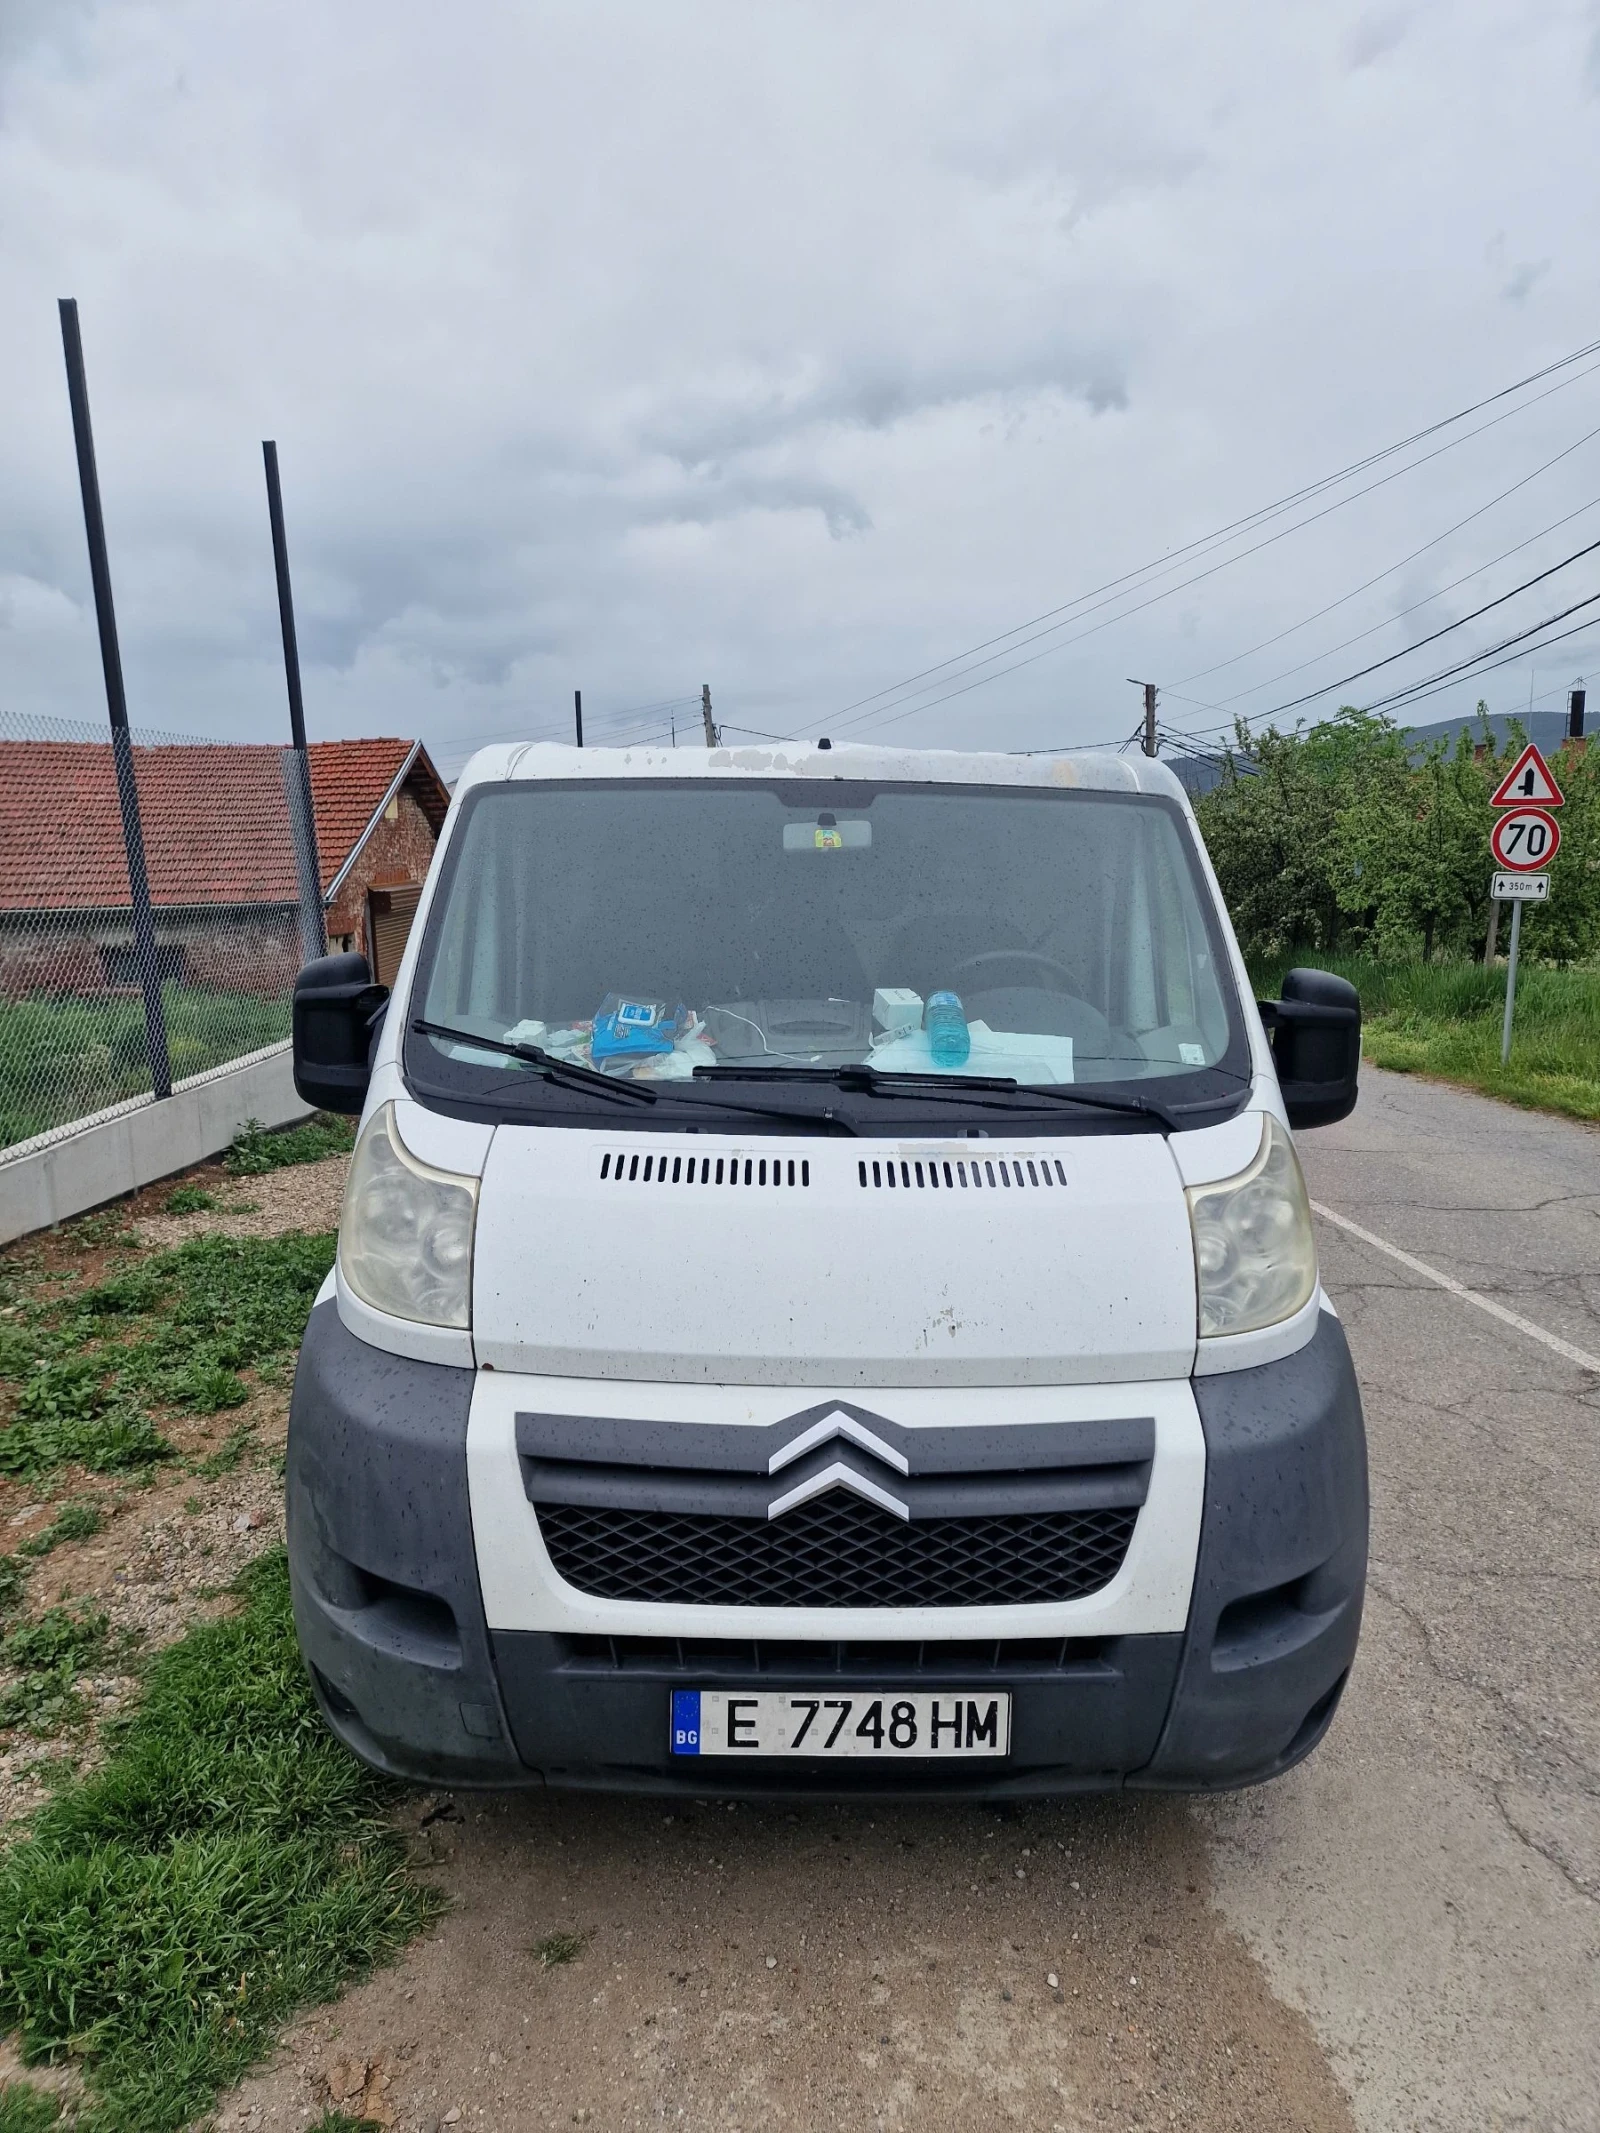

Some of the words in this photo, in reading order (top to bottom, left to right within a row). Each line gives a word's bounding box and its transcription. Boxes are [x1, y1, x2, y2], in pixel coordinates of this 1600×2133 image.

[1505, 824, 1547, 856] 70
[676, 1730, 698, 1745] BG
[727, 1699, 759, 1748] E
